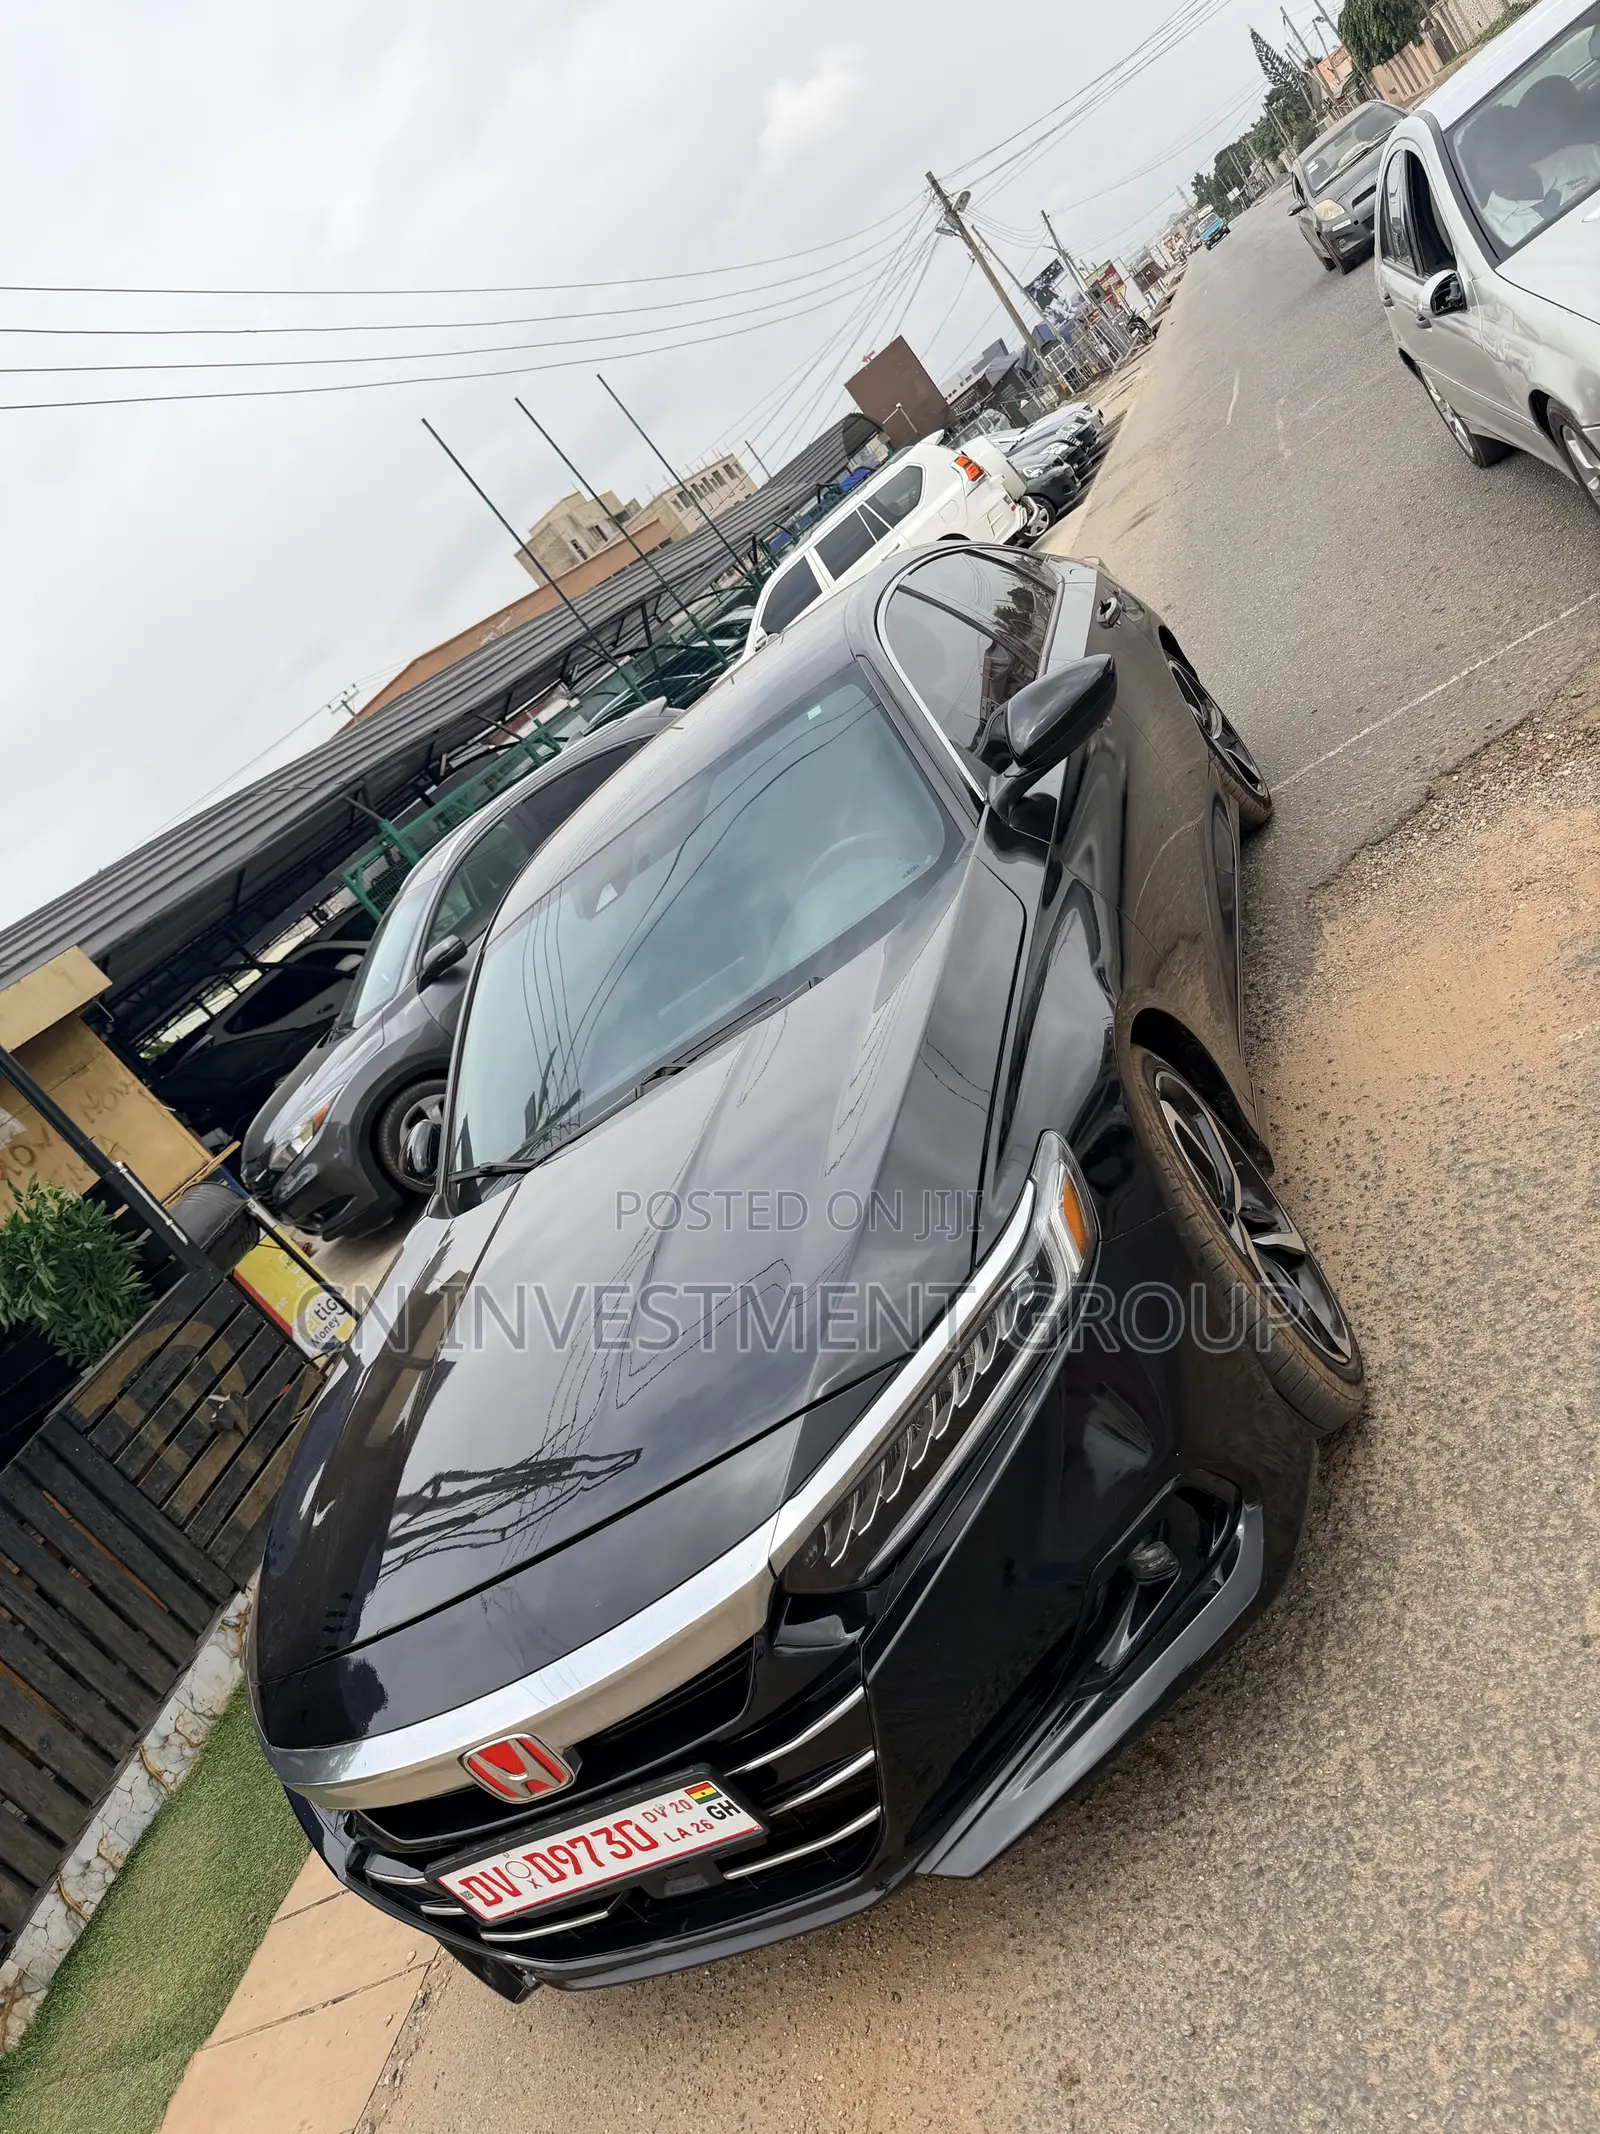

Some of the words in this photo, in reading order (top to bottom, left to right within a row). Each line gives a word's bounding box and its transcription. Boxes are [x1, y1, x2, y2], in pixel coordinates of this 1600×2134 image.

[310, 1315, 340, 1347] Money
[642, 1803, 669, 1823] DV
[669, 1799, 693, 1814] 20
[706, 1800, 741, 1820] GH
[663, 1827, 693, 1842] LA
[690, 1819, 715, 1833] 26
[458, 1866, 523, 1907] DV
